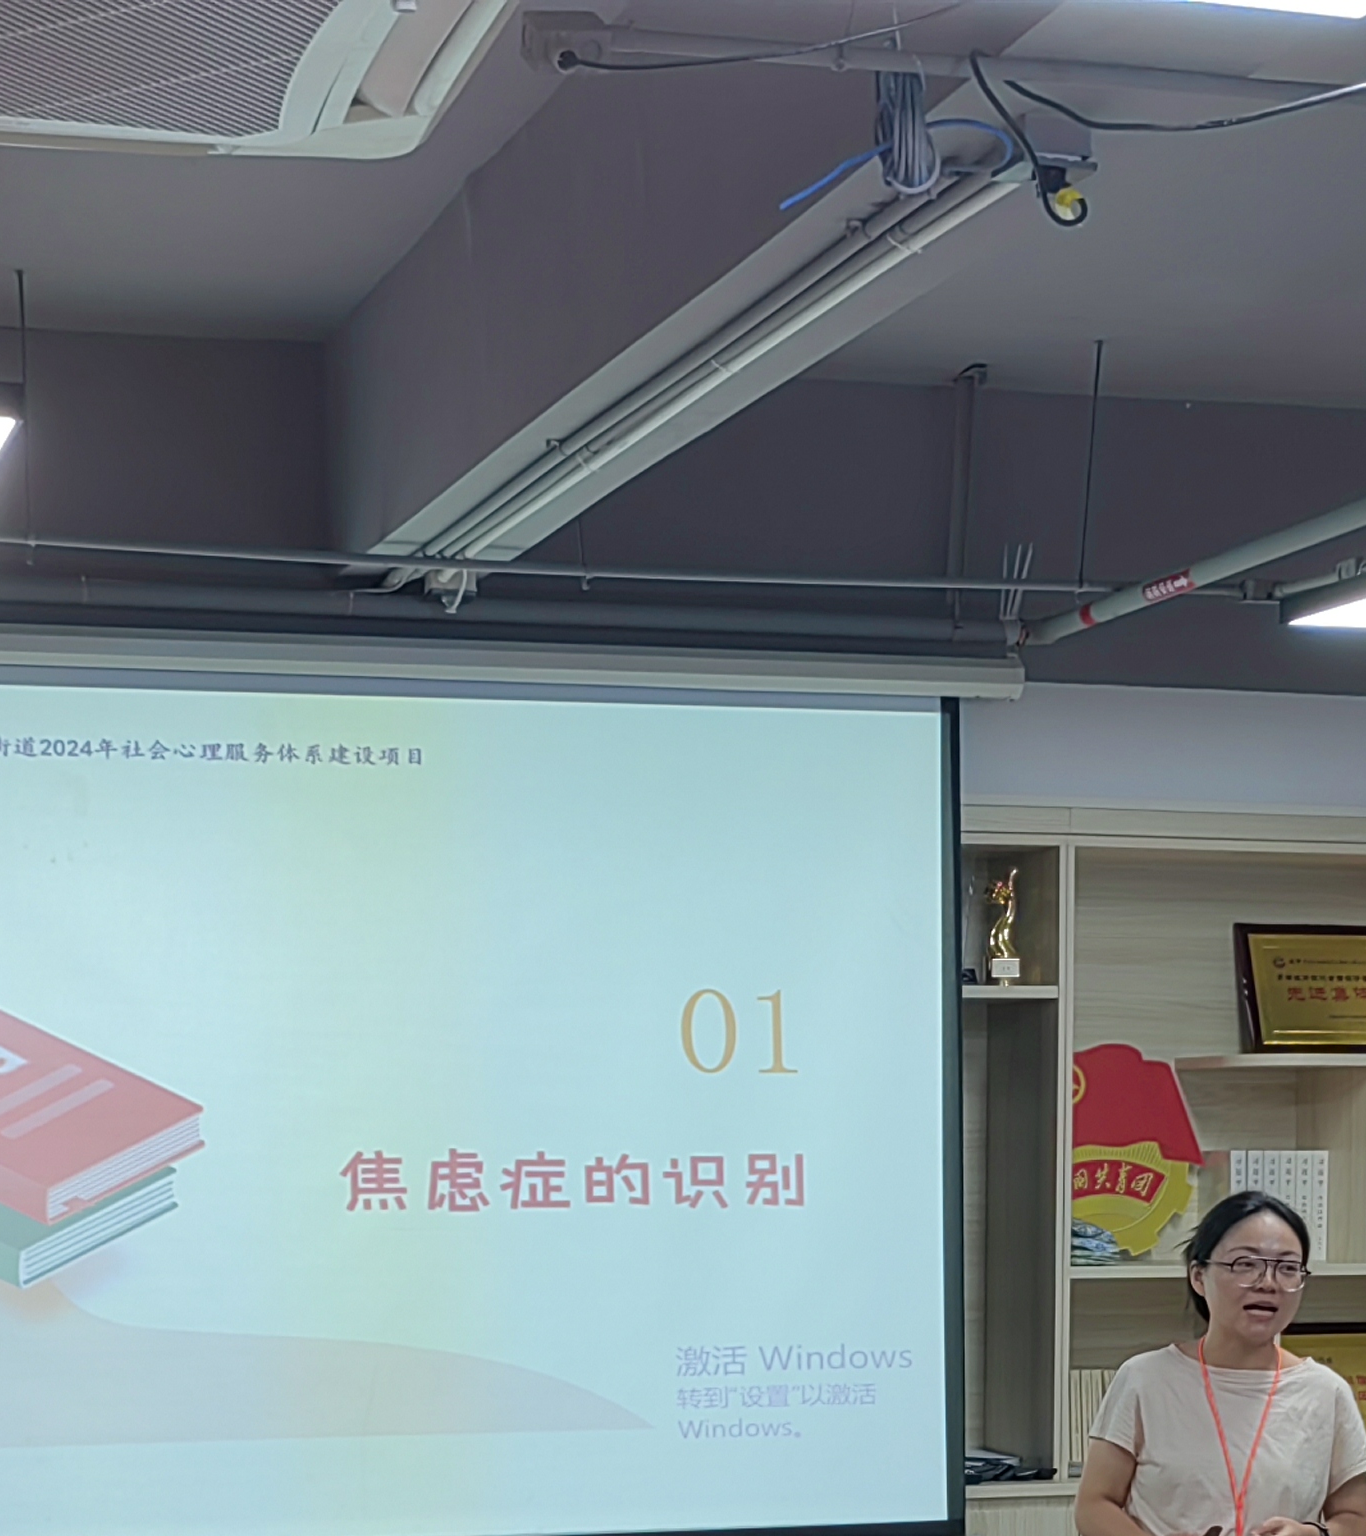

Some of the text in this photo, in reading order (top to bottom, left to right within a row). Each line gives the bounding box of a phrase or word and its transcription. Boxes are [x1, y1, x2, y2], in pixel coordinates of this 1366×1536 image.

[680, 988, 799, 1074] 01
[339, 1148, 805, 1213] 焦虑症的识别
[675, 1343, 913, 1377] 激活 Windows
